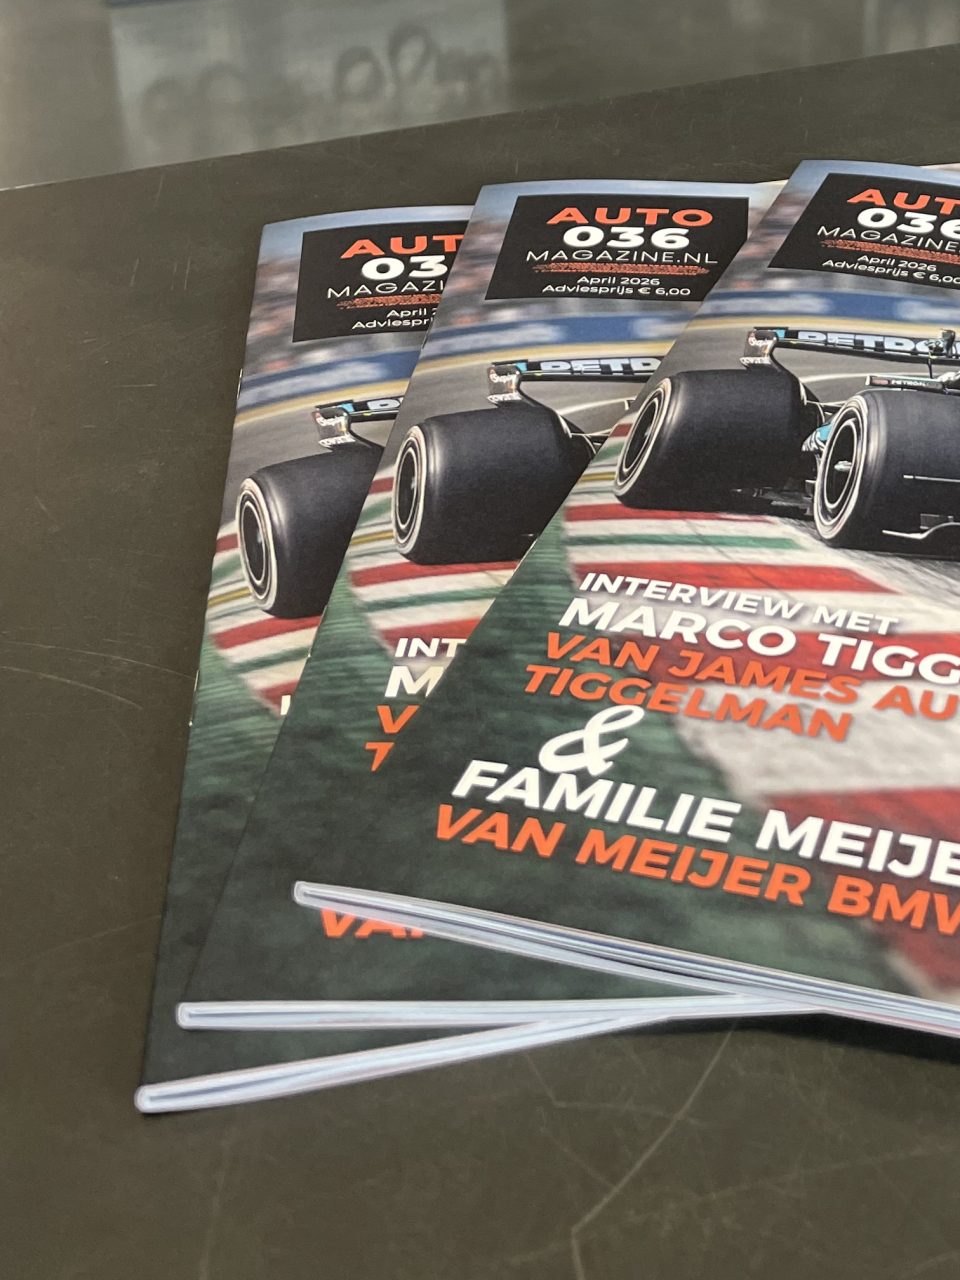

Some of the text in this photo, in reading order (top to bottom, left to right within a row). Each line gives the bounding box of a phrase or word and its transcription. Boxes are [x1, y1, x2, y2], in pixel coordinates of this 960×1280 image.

[546, 207, 713, 227] AUTO
[340, 234, 465, 259] AUT
[563, 225, 690, 250] 036
[361, 254, 448, 280] 03
[526, 249, 718, 264] MAGAZINE.NL
[822, 259, 909, 277] Adviesprijs
[913, 271, 926, 279] €
[857, 255, 937, 271] April 2026
[542, 284, 691, 296] Adviesprijs € 6,00
[577, 276, 660, 286] April 2026
[387, 308, 427, 318] April
[579, 572, 899, 636] INTERVIEW MET
[558, 597, 797, 657] MARCO
[545, 631, 653, 671] VAN
[669, 649, 862, 704] JAMES
[524, 663, 852, 742] TIGGELMAN
[538, 704, 645, 776] &
[451, 759, 742, 842] FAMILIE
[435, 803, 566, 858] VAN
[575, 827, 811, 906] MEIJER
[321, 908, 424, 938] VA
